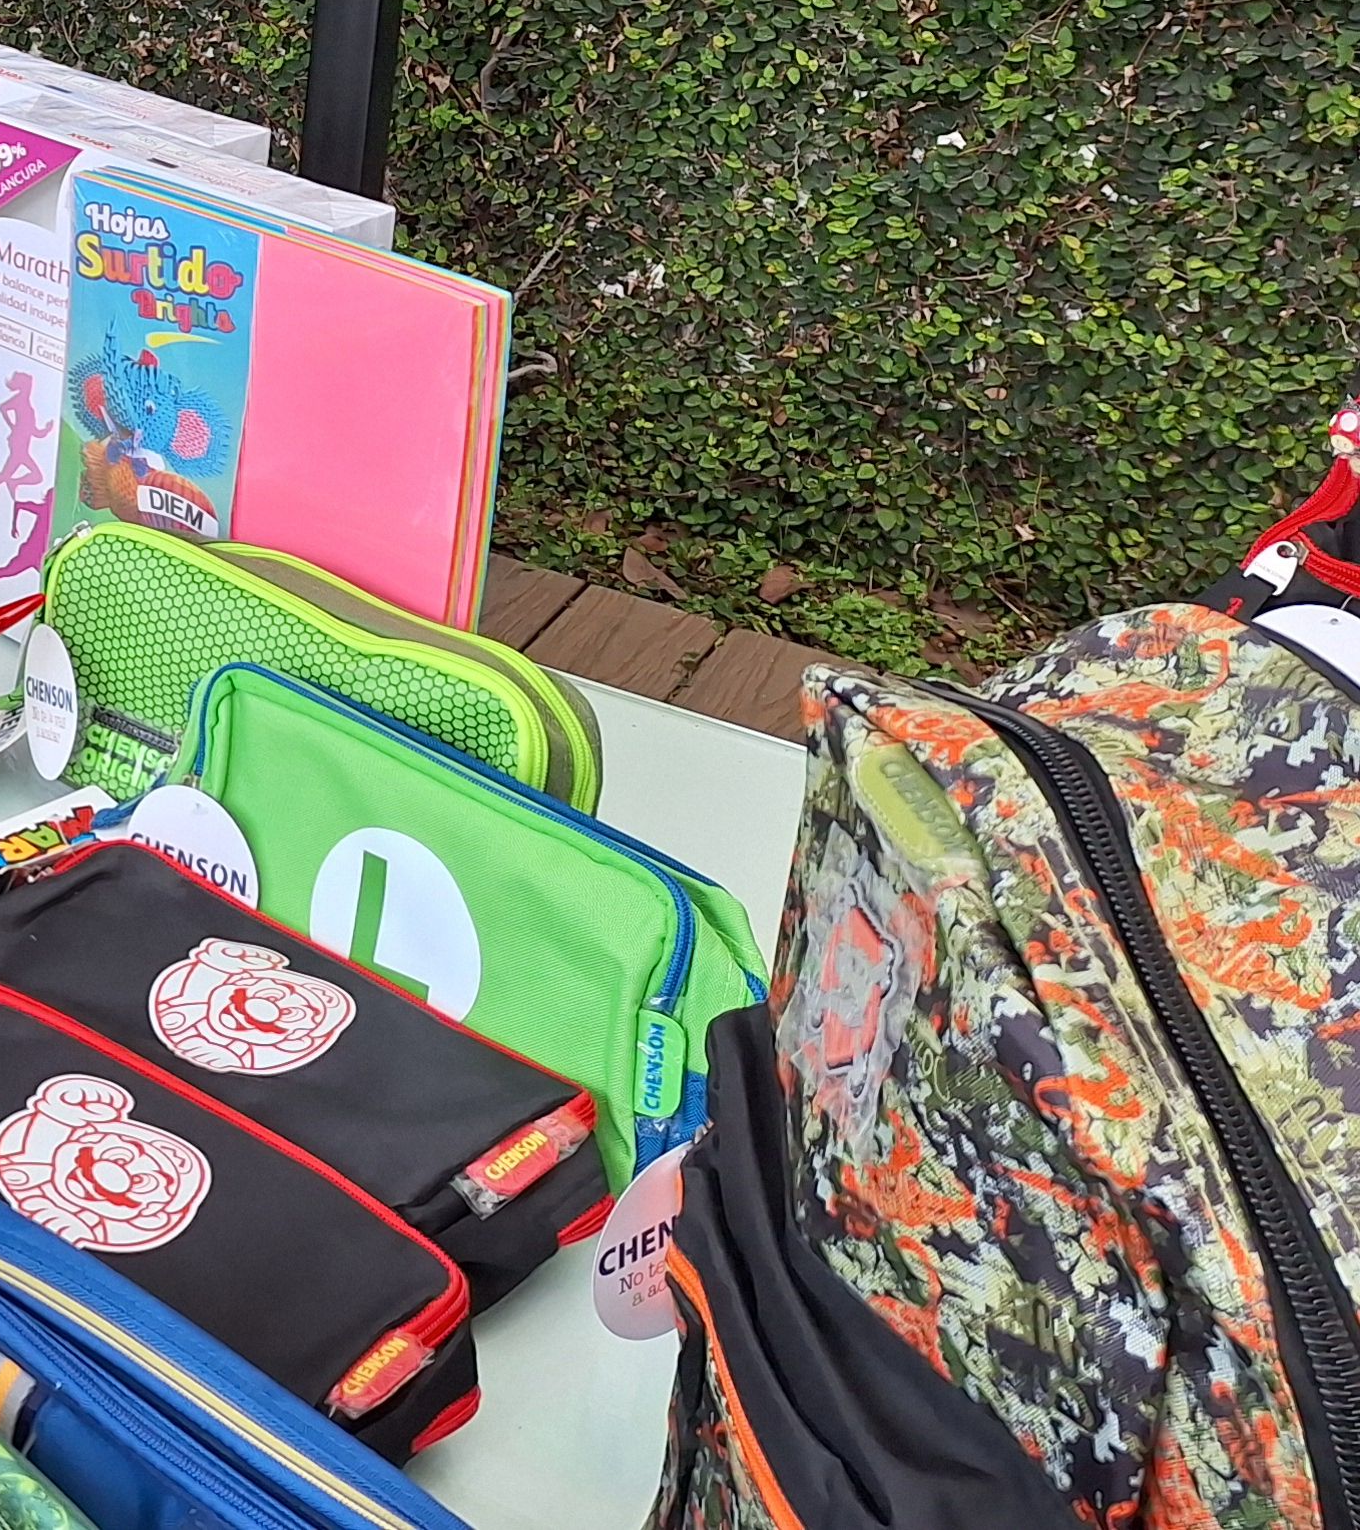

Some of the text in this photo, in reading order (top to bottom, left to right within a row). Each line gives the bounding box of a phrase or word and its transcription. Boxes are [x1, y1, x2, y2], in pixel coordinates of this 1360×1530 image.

[84, 202, 169, 243] Hojas
[1, 274, 45, 301] balance
[76, 233, 244, 300] Surtido
[131, 289, 236, 334] Brights
[149, 488, 204, 532] DIEM
[25, 675, 73, 714] CHENSON
[878, 758, 968, 856] CHENSON
[348, 849, 430, 1002] L
[644, 1020, 666, 1111] CHENSON
[485, 1130, 549, 1182] CHENSON
[619, 1272, 644, 1296] No
[341, 1335, 409, 1396] CHENSON
